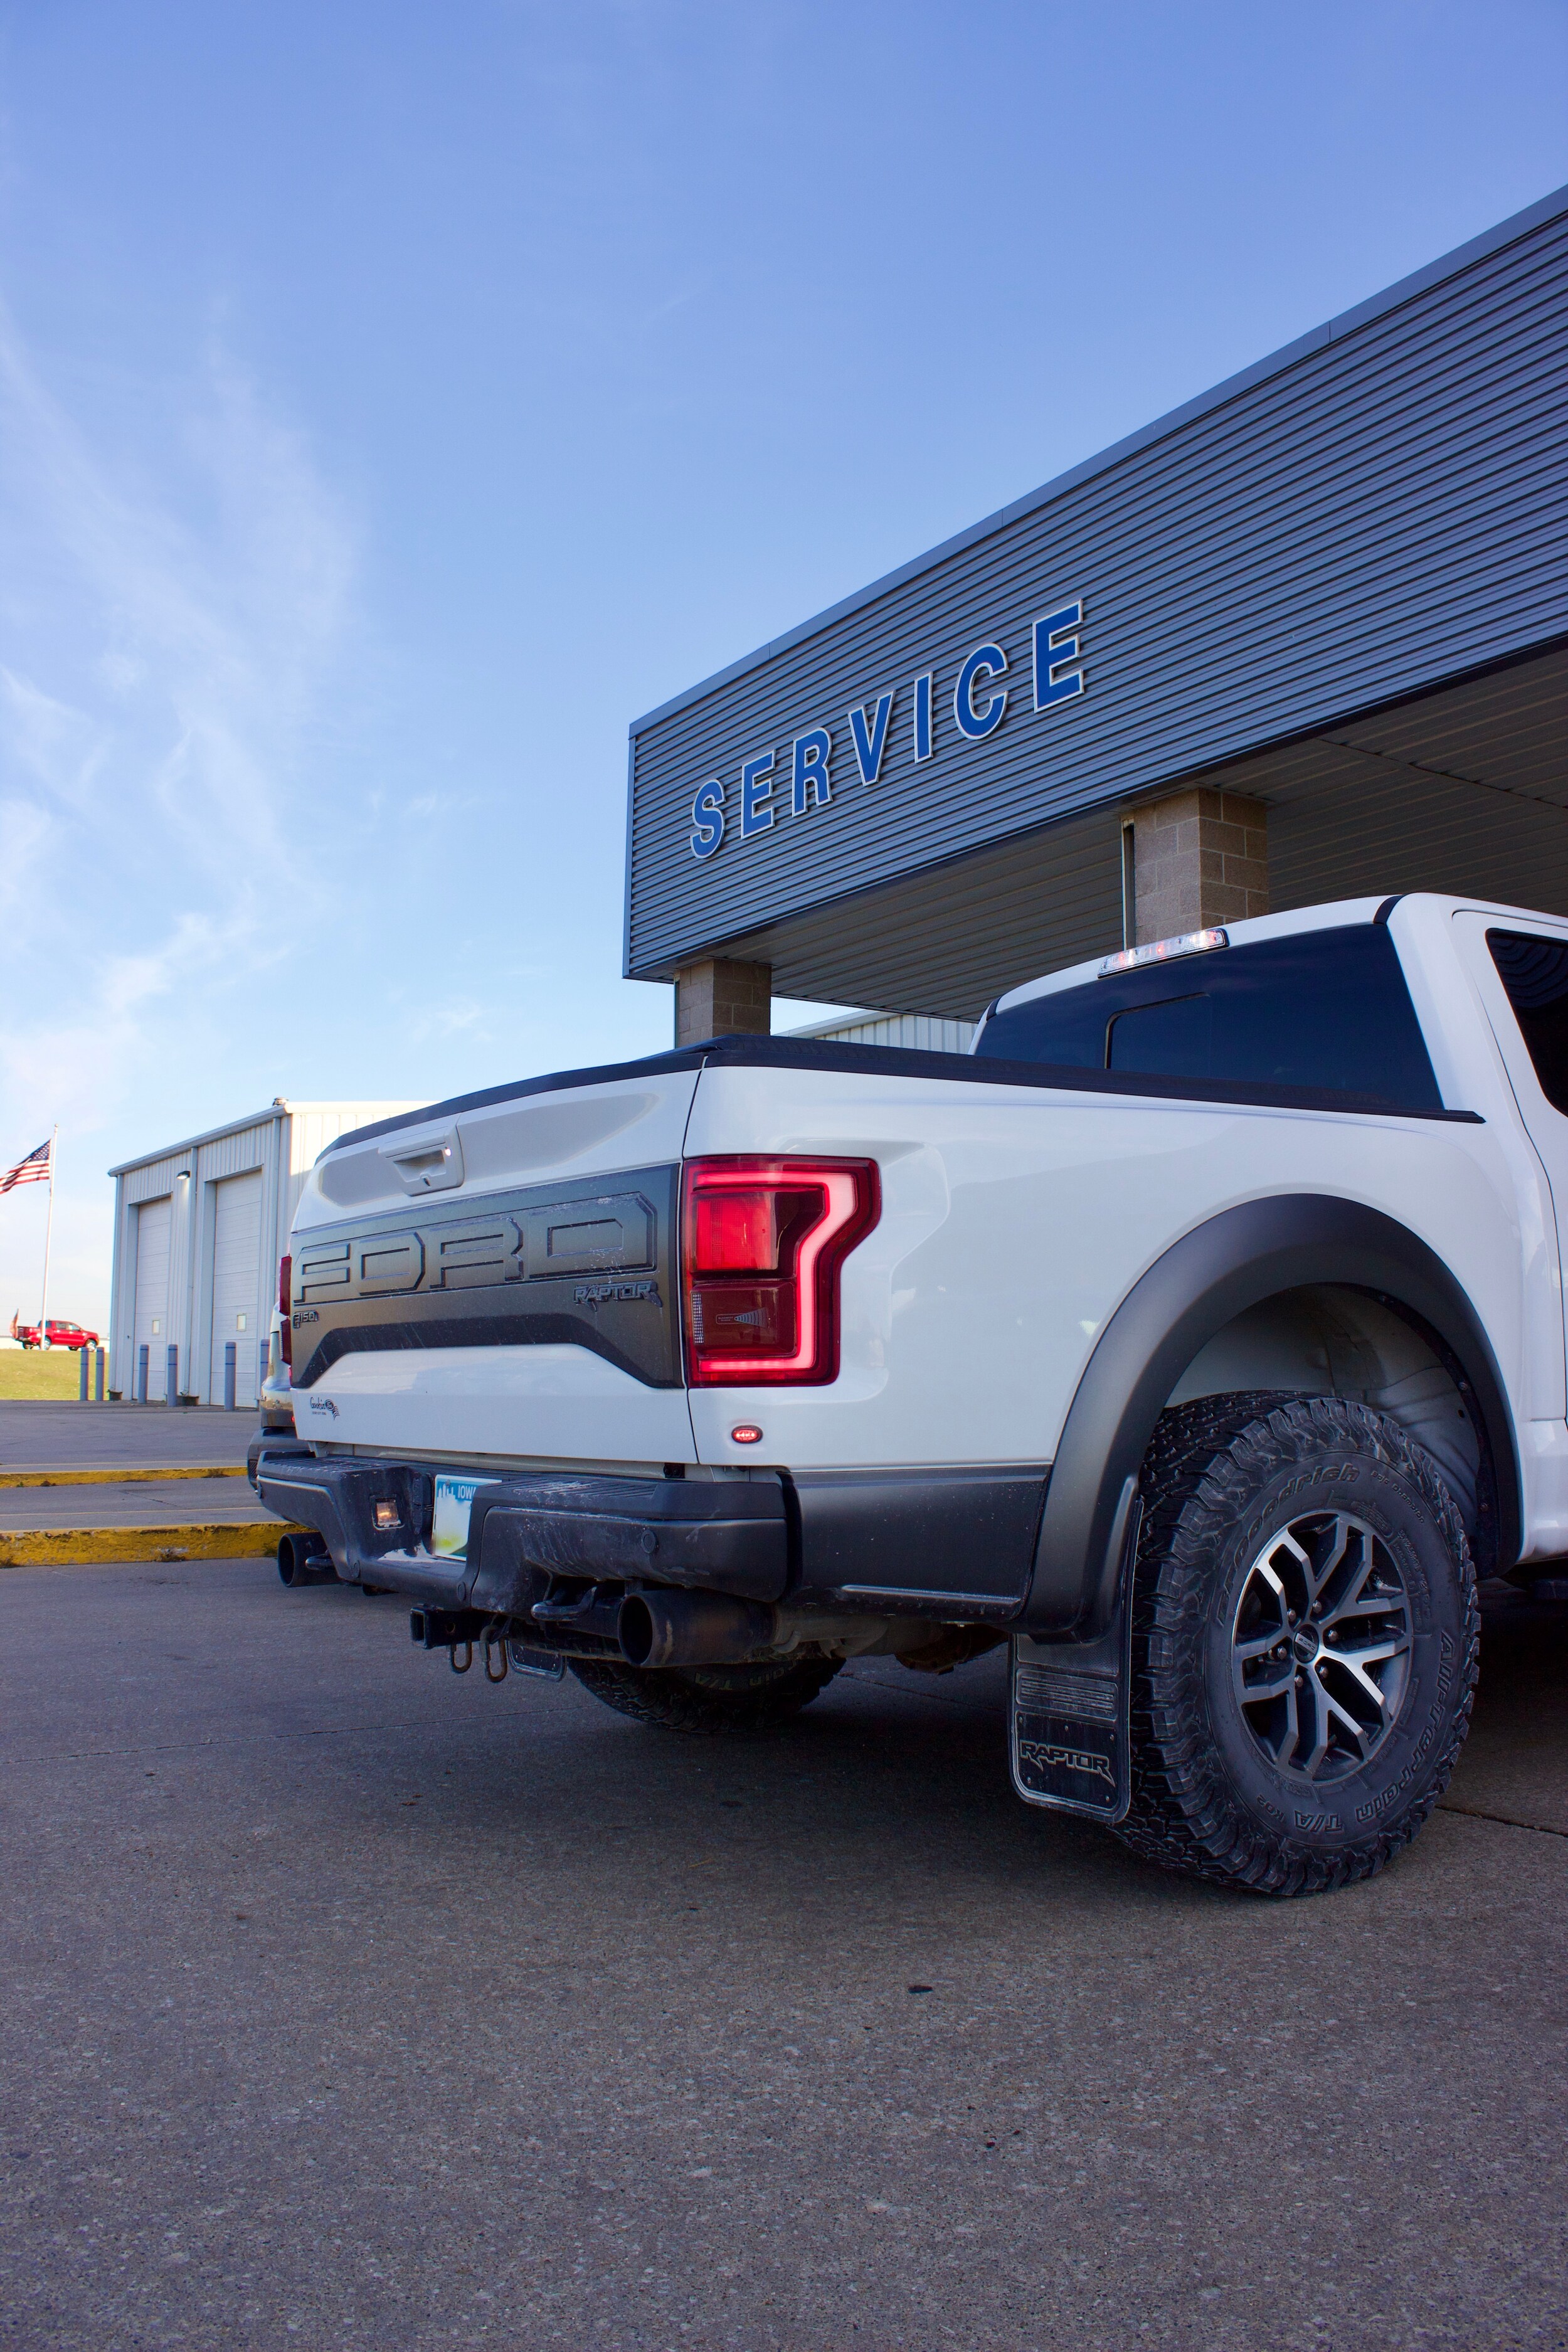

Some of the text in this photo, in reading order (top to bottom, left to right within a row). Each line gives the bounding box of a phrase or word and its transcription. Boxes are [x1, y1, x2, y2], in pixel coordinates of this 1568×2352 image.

[690, 598, 1086, 859] SERVICE
[294, 1192, 657, 1305] FORD
[573, 1279, 663, 1312] RAPTOR
[1019, 1740, 1115, 1787] RAPTOR
[1356, 1631, 1454, 1823] All-Terrain
[1295, 1809, 1343, 1833] T/A
